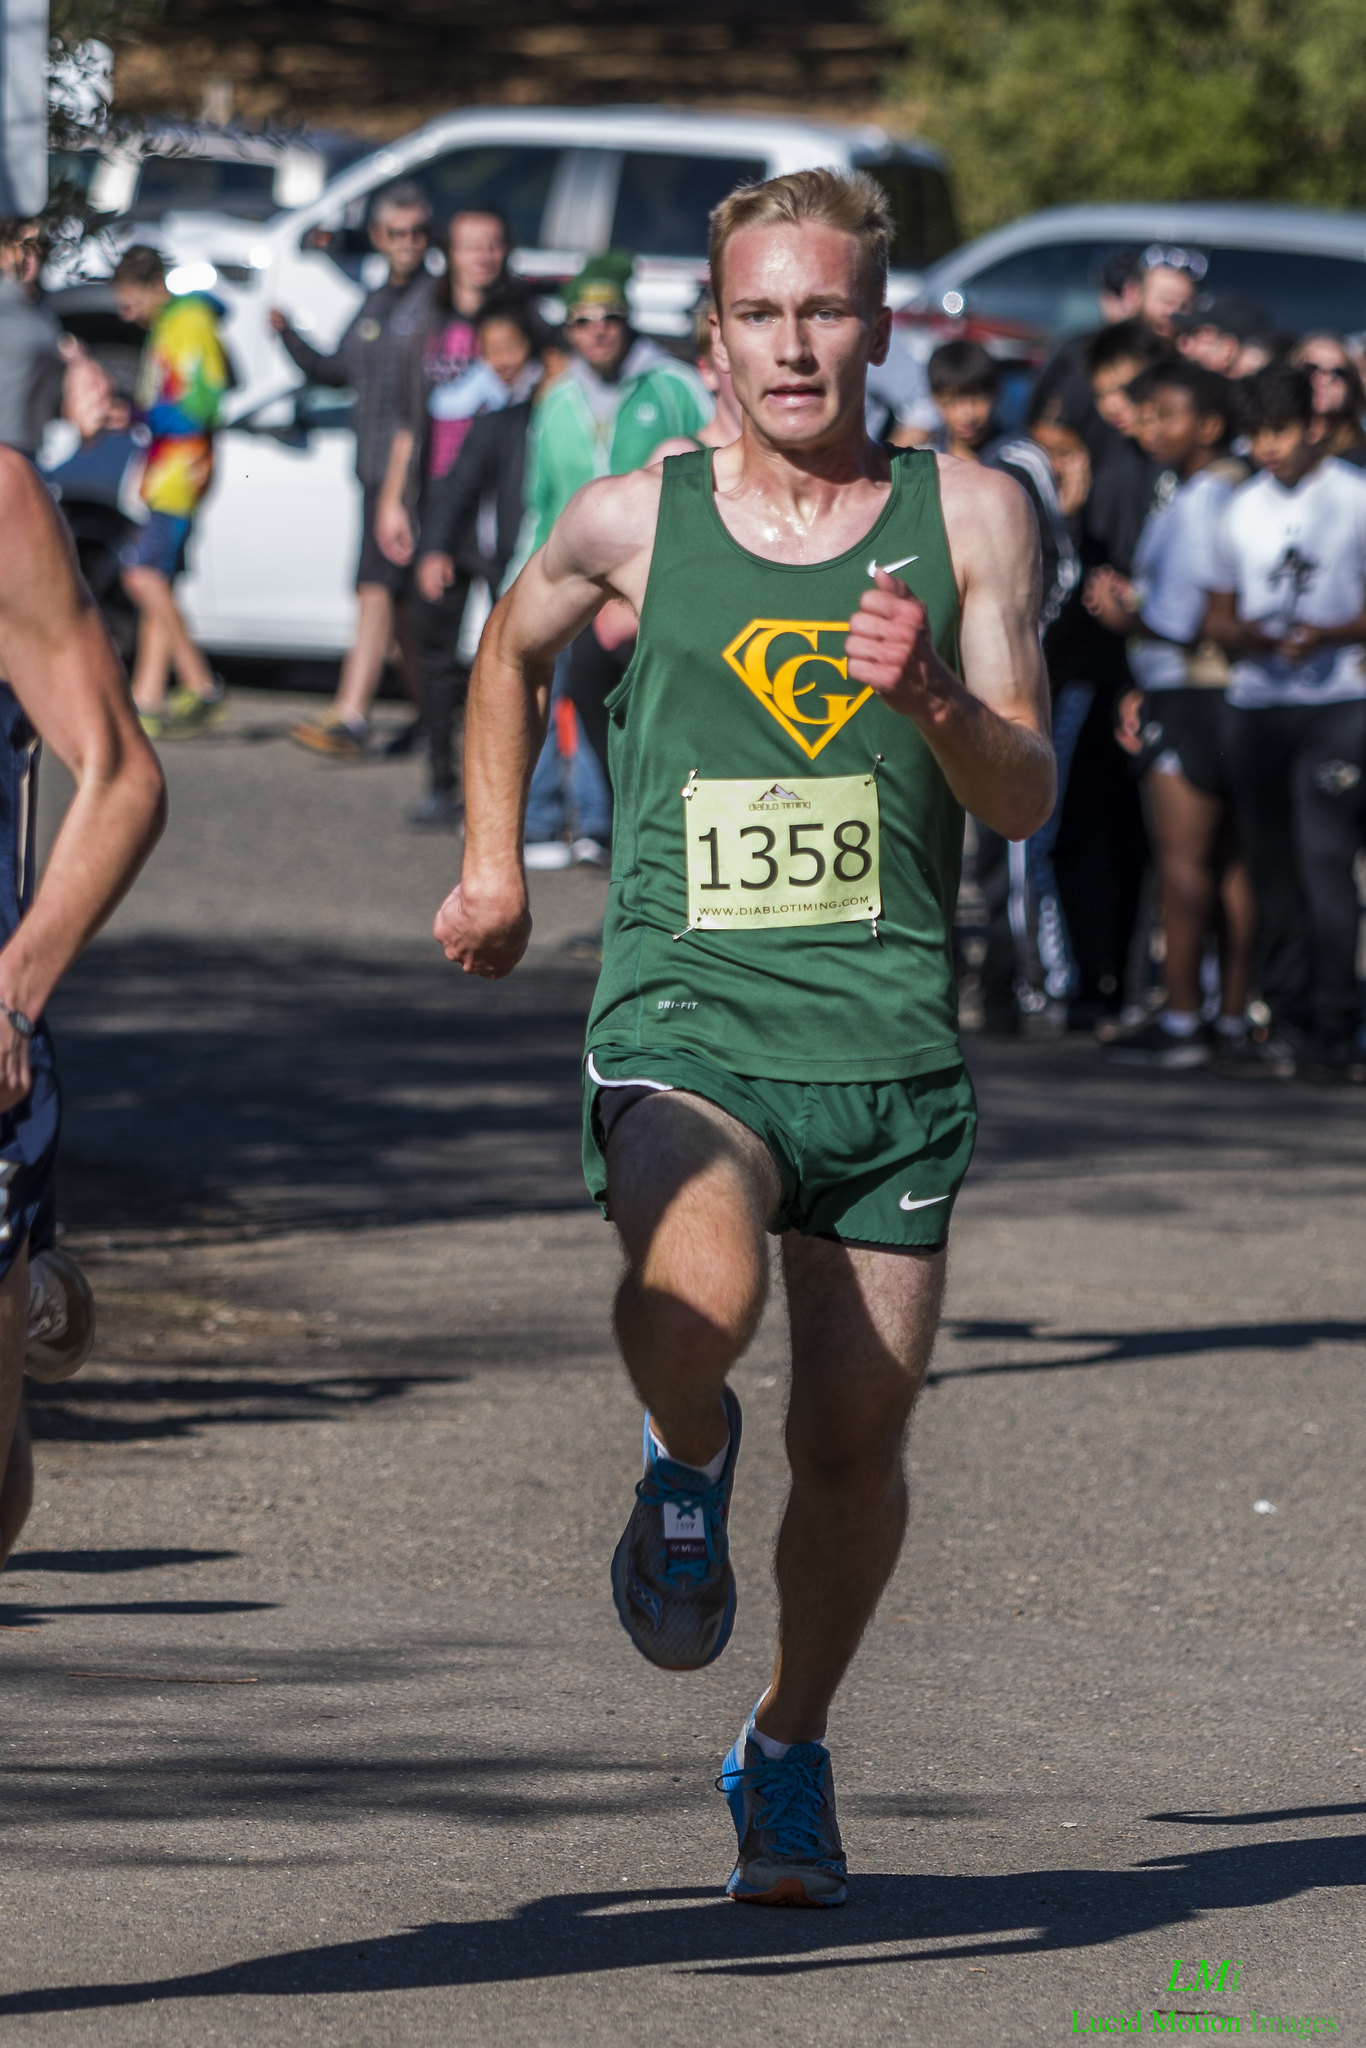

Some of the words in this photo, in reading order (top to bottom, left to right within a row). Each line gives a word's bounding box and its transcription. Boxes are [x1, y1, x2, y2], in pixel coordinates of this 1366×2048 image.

[699, 820, 872, 891] 1358
[699, 896, 870, 916] WWW.DIABLOTIMING.COM
[657, 1001, 698, 1010] DRI-FIT
